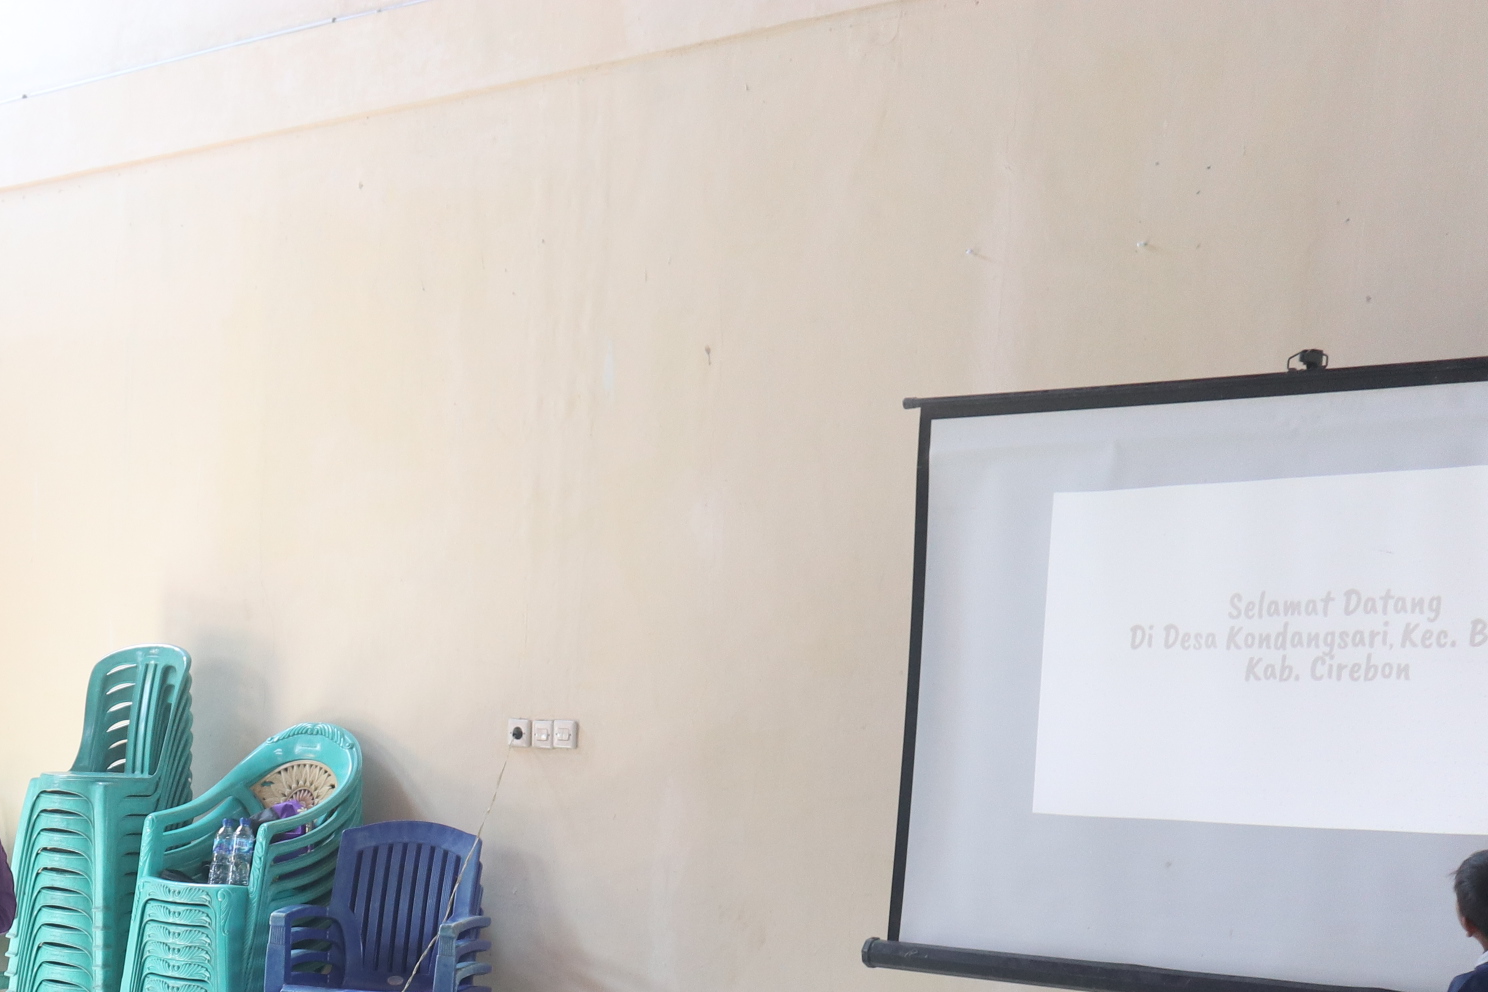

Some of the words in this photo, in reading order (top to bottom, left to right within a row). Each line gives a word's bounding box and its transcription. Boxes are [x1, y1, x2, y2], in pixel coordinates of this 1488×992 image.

[1228, 591, 1336, 619] Selamat
[1344, 588, 1442, 623] Datang
[1130, 624, 1155, 650] Di
[1164, 624, 1217, 651] Desa
[1226, 621, 1394, 655] Kondangsari,
[1401, 622, 1457, 649] Kec.
[1245, 654, 1300, 682] Kab.
[1311, 653, 1410, 682] Cirebon
